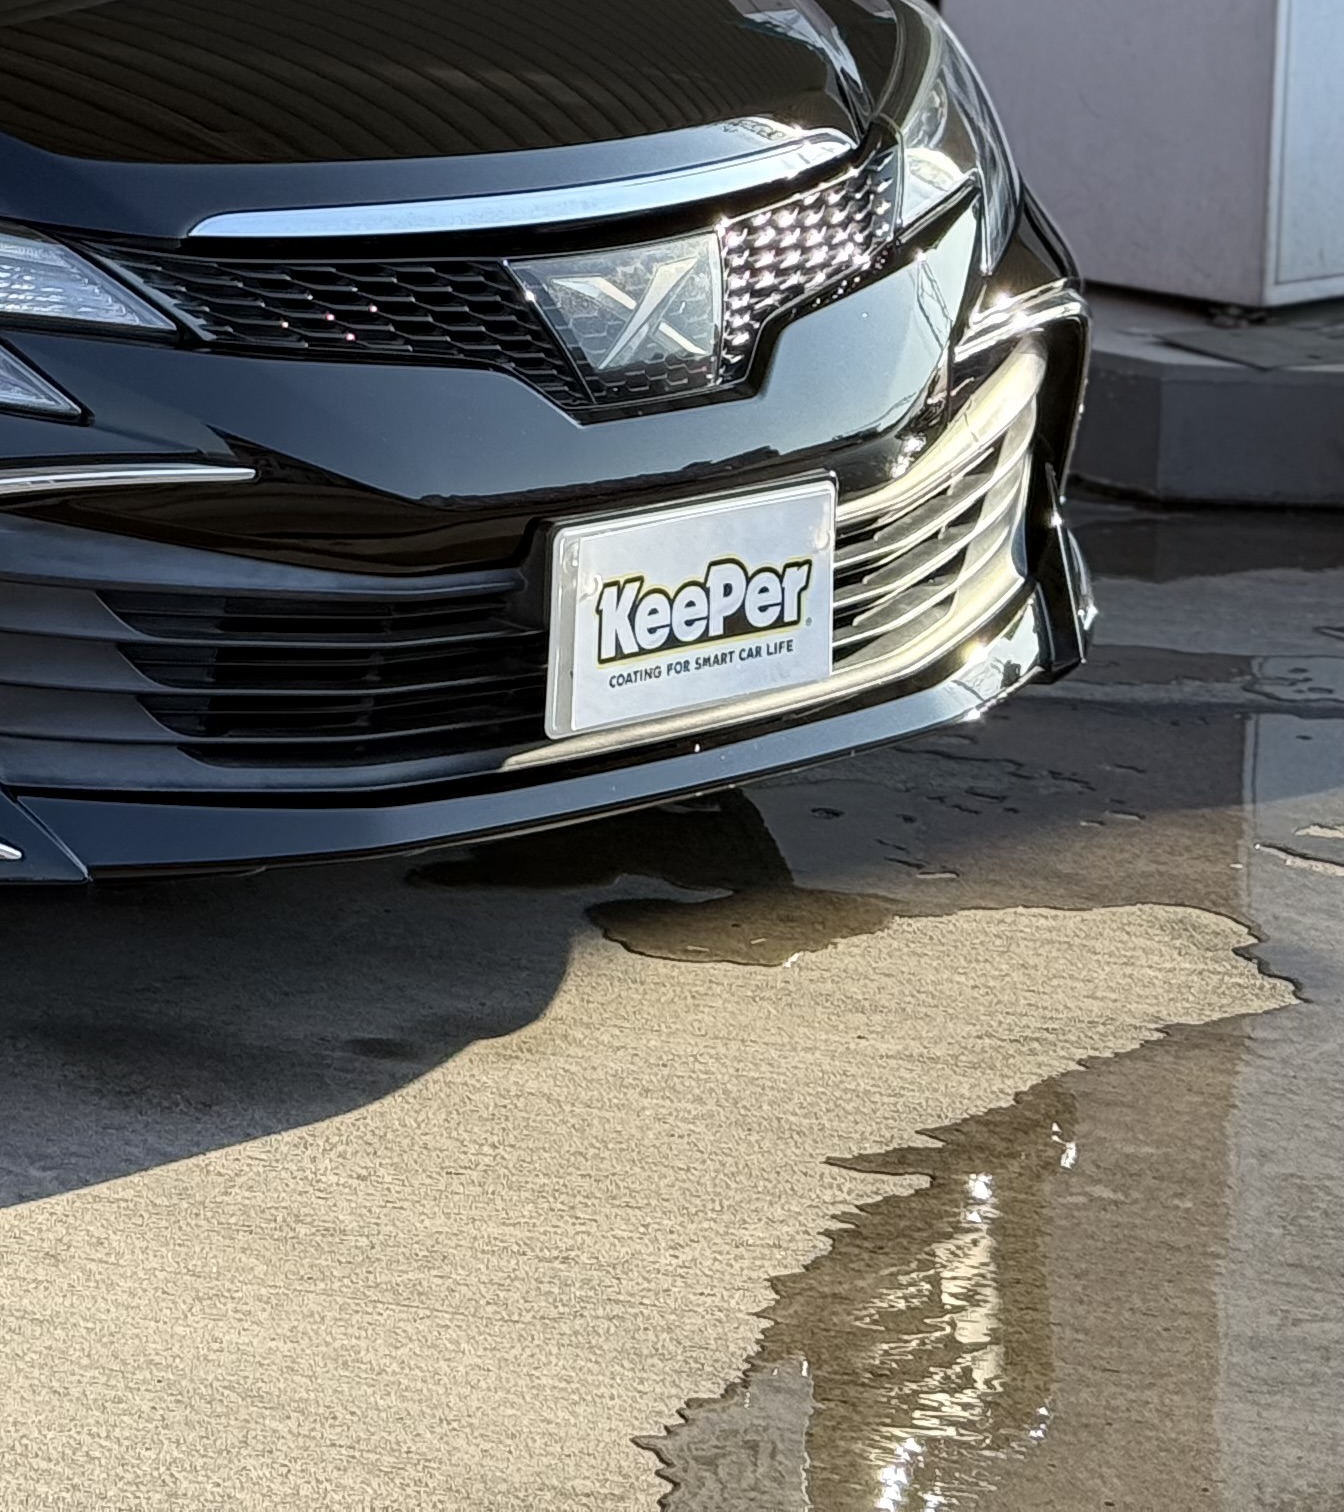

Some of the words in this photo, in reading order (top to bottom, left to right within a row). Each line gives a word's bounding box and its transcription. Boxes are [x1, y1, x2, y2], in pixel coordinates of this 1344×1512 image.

[595, 557, 812, 665] KeePer
[609, 665, 662, 688] COATING
[667, 659, 690, 676] FOR
[694, 650, 735, 670] SMART
[739, 645, 762, 661] CAR
[766, 639, 794, 656] LIFE
